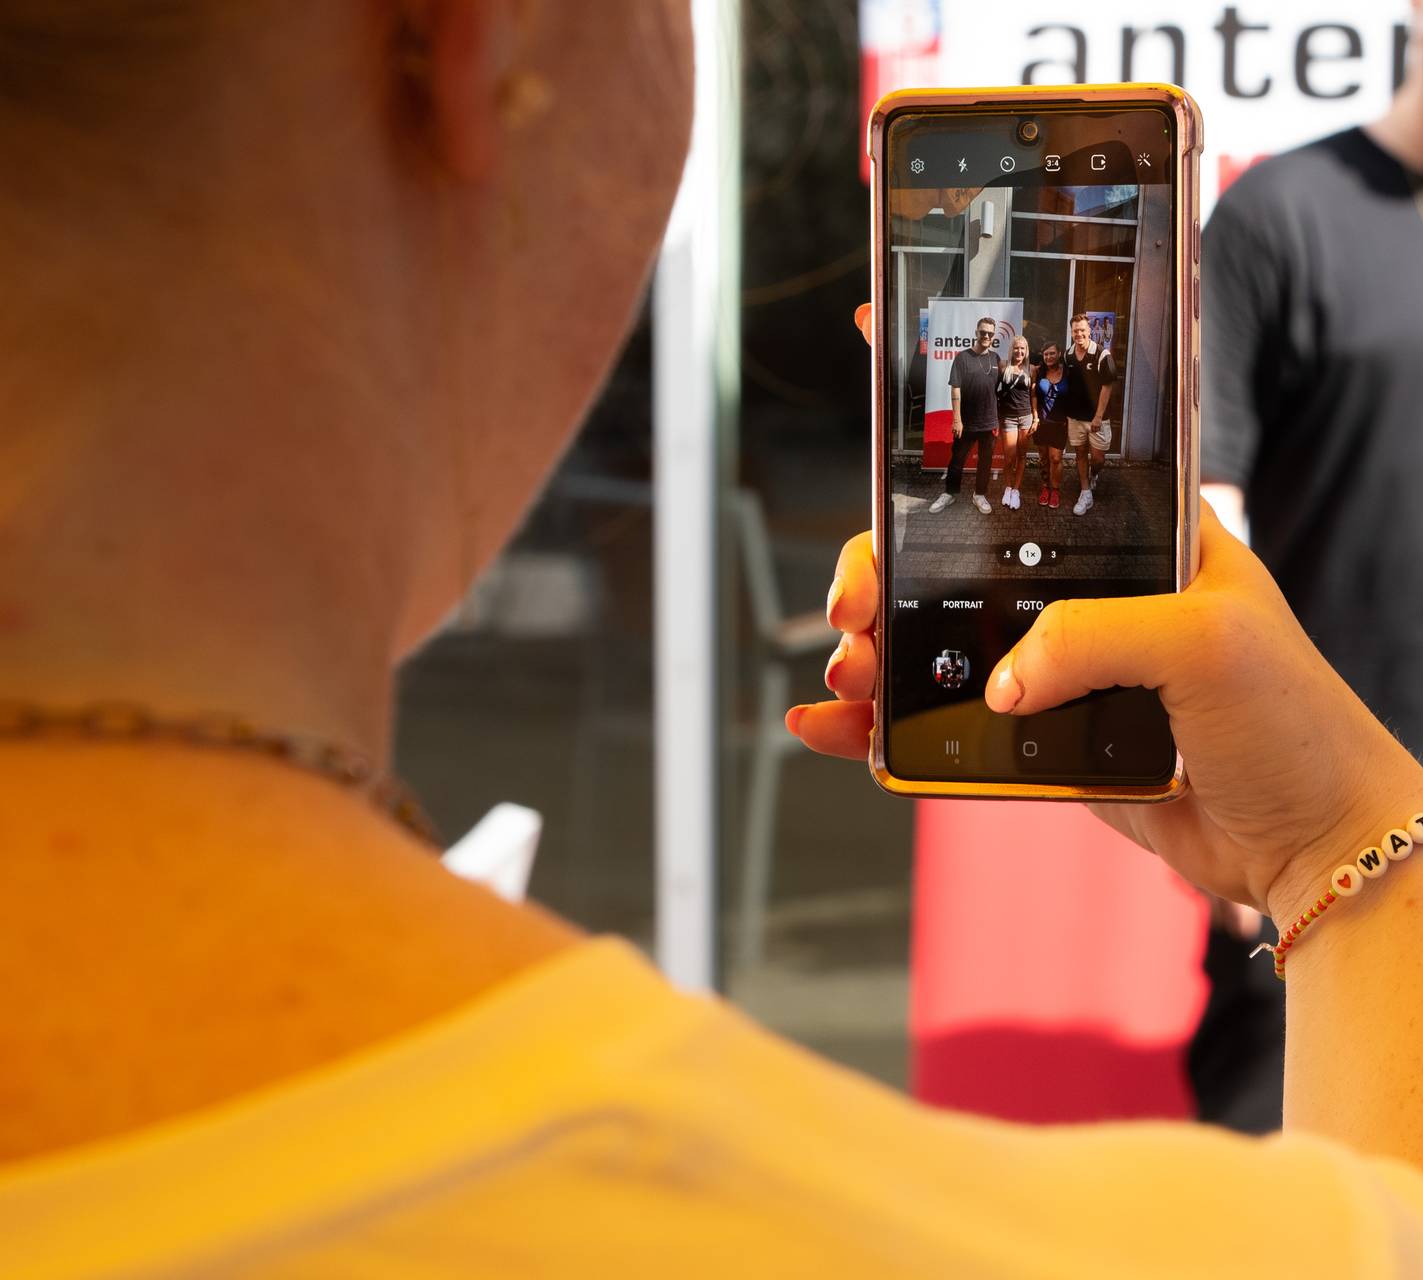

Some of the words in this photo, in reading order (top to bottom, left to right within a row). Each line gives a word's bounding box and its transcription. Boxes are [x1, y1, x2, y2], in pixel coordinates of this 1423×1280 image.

[1003, 550, 1011, 559] .5
[1051, 550, 1057, 559] 3
[898, 600, 919, 609] TAKE
[943, 600, 984, 609] PORTRAIT
[1016, 600, 1044, 611] FOTO
